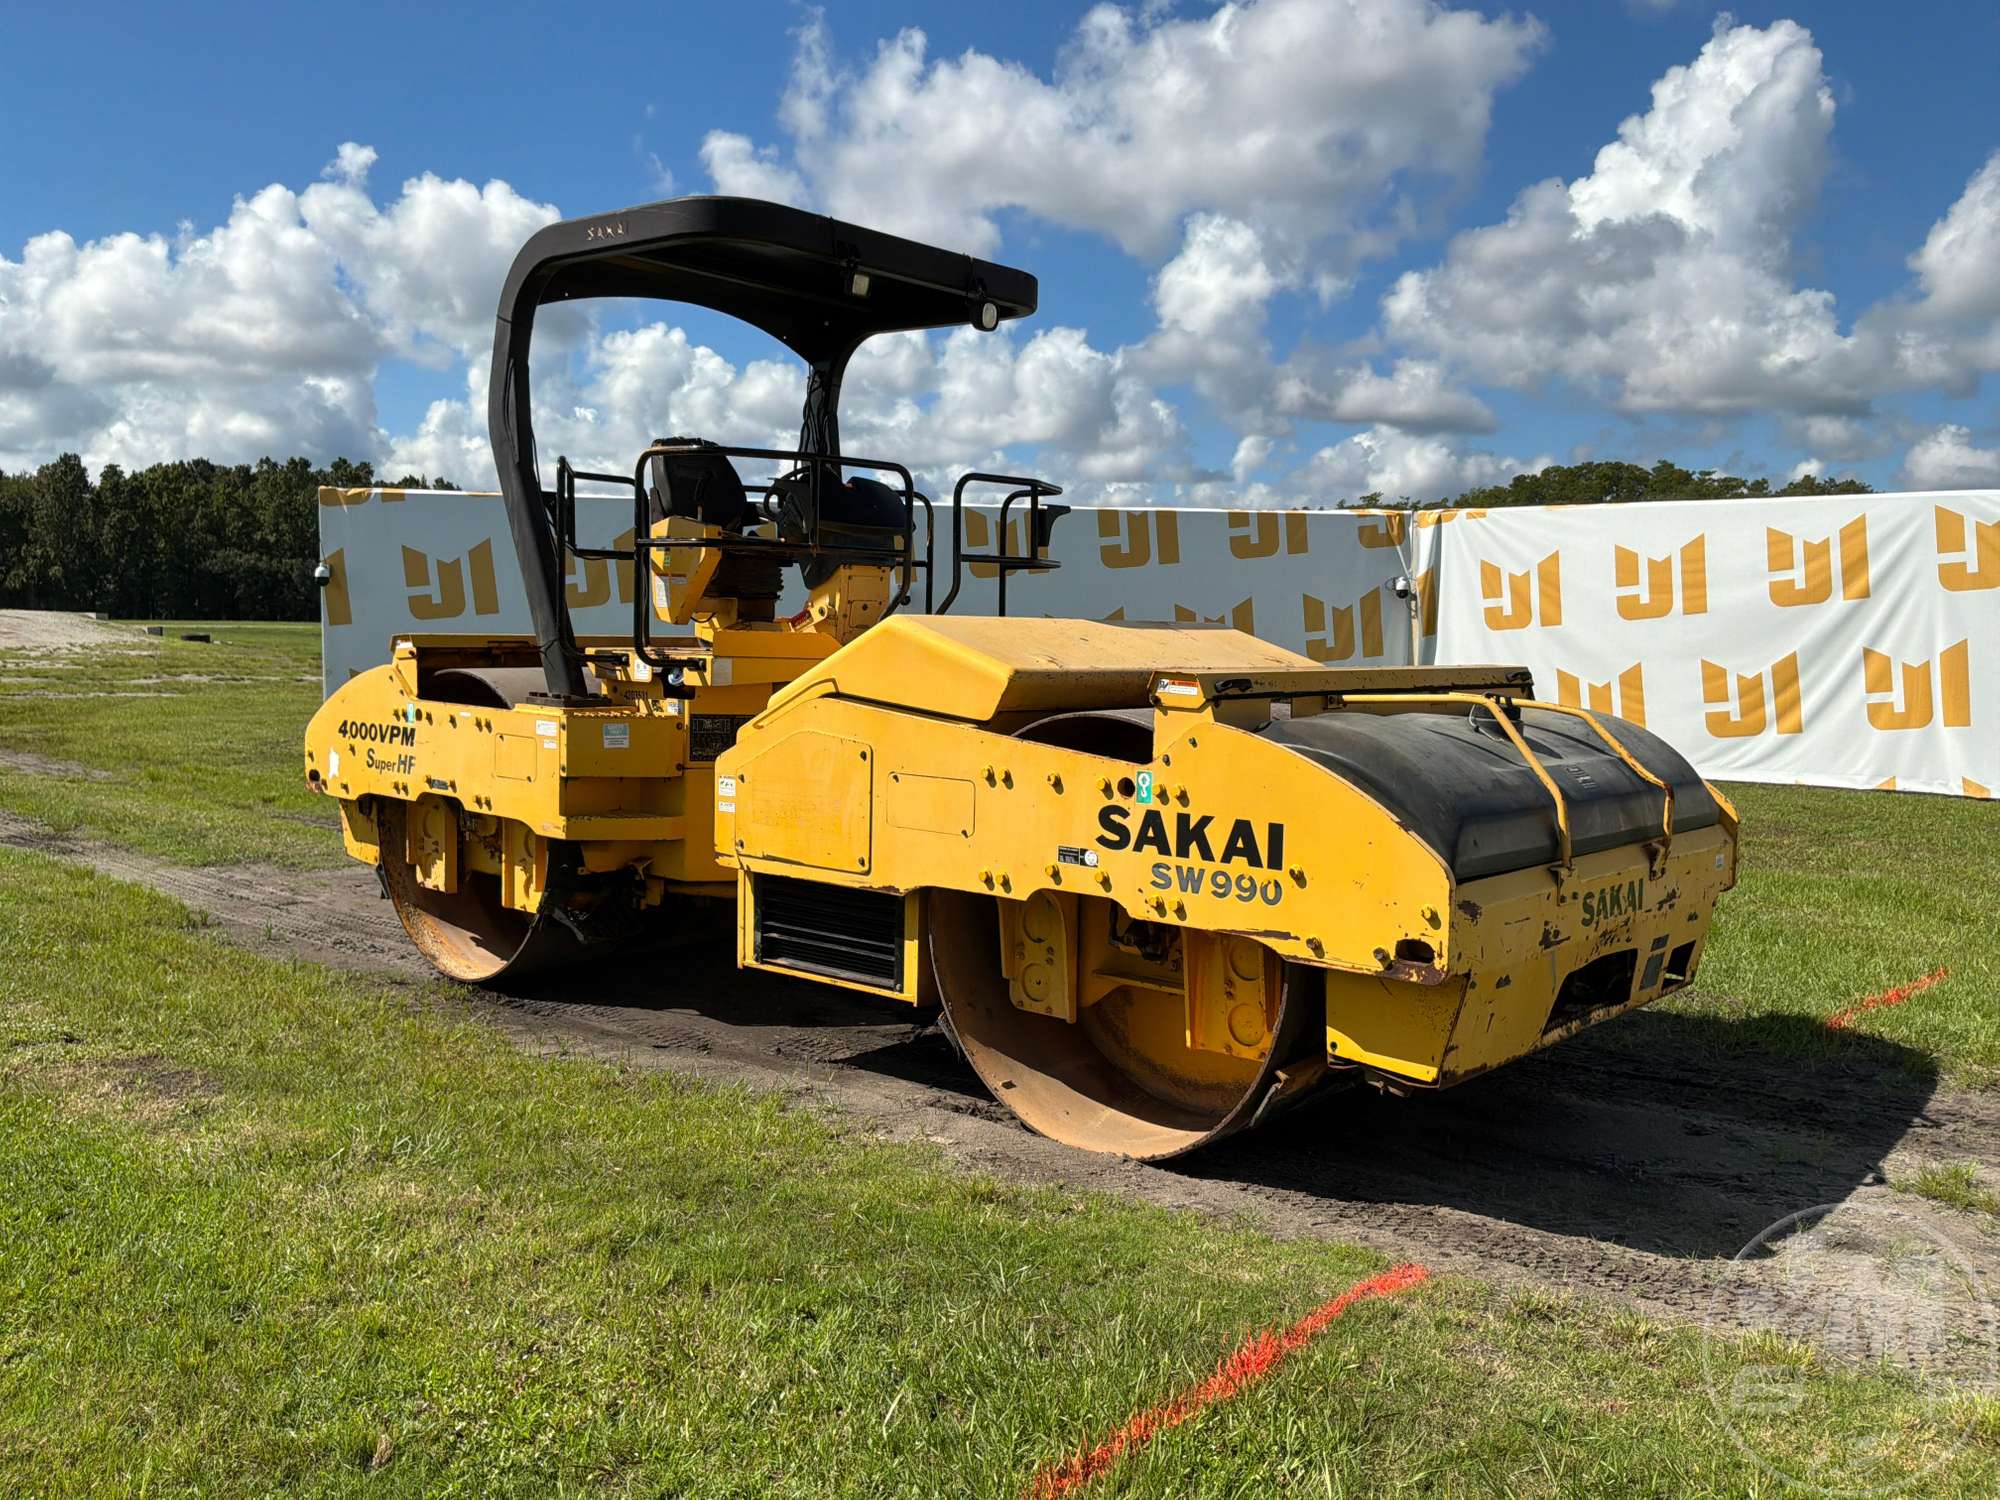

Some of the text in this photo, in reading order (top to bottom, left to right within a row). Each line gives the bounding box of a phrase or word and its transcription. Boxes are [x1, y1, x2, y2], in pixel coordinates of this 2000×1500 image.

[1095, 804, 1285, 871] SAKAI
[1150, 862, 1282, 906] SW990
[1581, 878, 1645, 927] SAKAI
